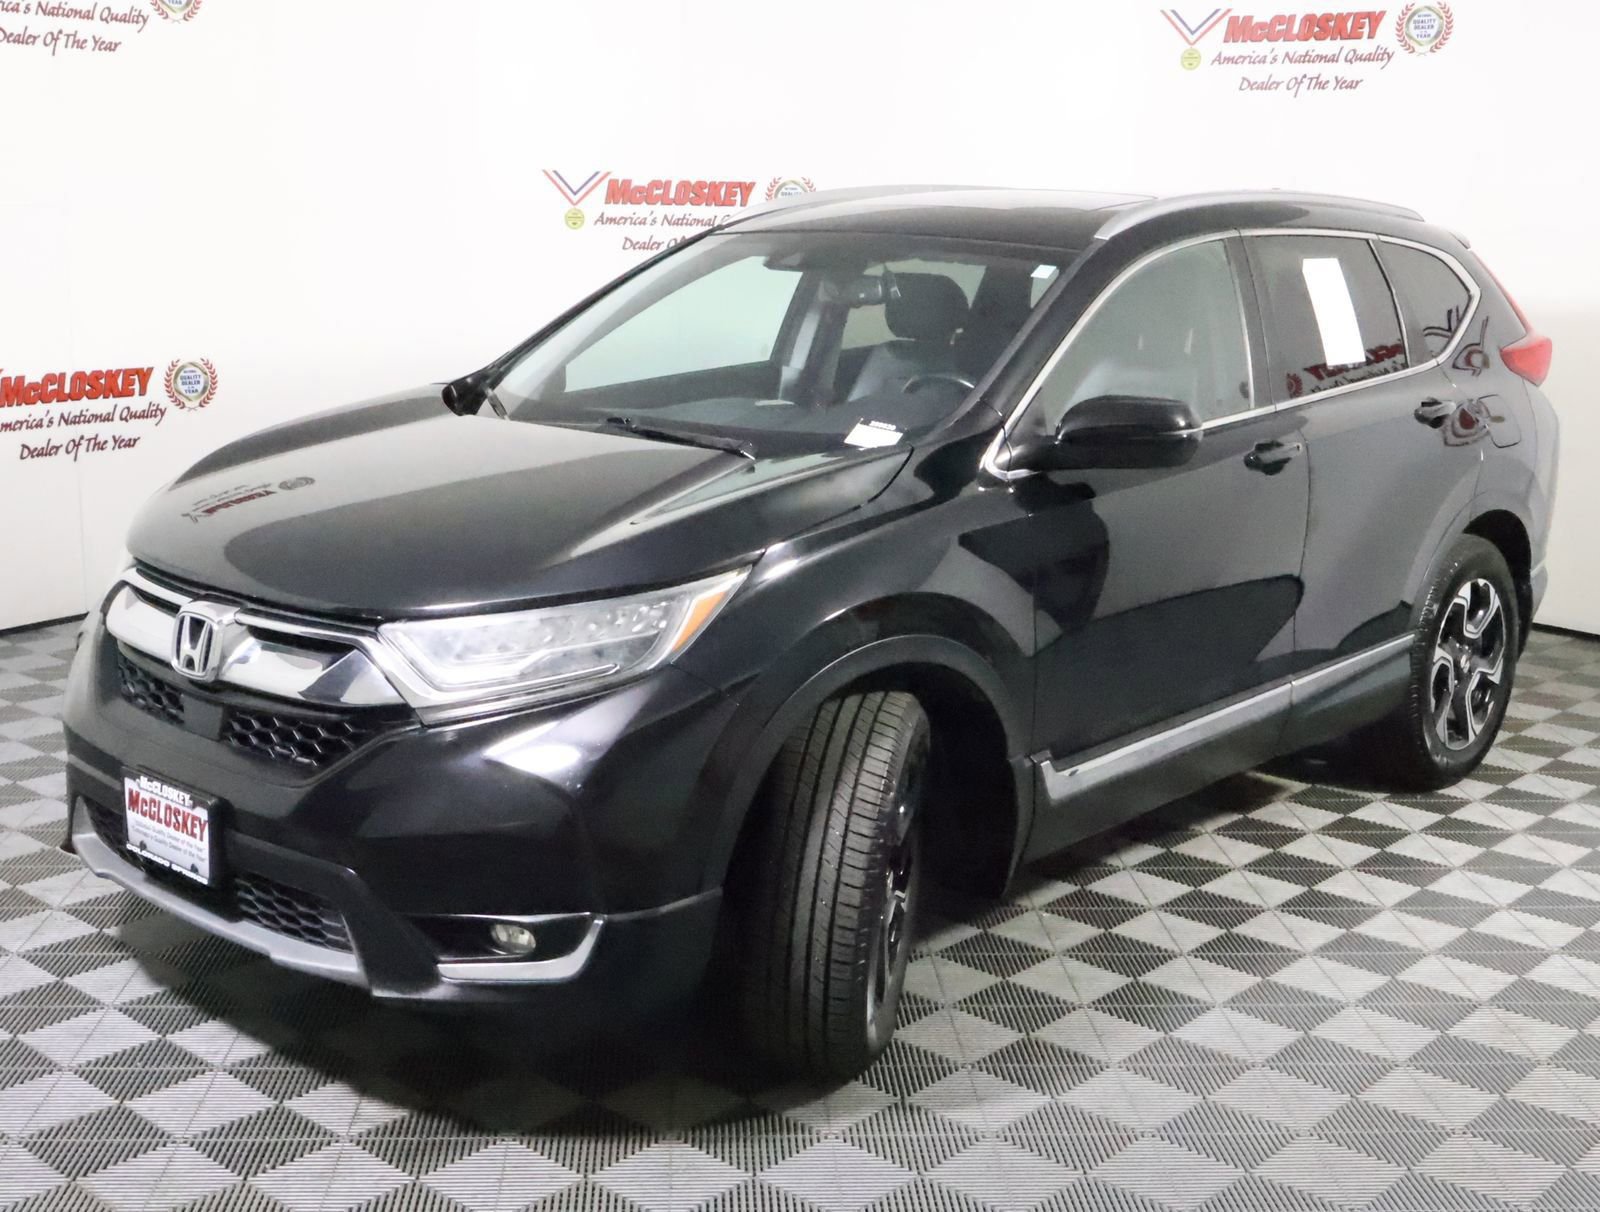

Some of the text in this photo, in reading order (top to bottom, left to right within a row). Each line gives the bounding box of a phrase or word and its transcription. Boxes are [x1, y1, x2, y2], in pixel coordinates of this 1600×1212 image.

[35, 0, 97, 21] National
[99, 6, 149, 33] Quality
[1223, 10, 1387, 43] McCLOSKEY
[43, 29, 63, 56] Of
[64, 30, 88, 50] The
[92, 35, 122, 52] Year
[1210, 48, 1278, 66] America's
[1282, 46, 1344, 65] National
[1344, 44, 1395, 70] Quality
[1238, 72, 1364, 98] Dealer Of The Year
[604, 179, 756, 207] McCLOSKEY
[593, 210, 657, 226] America's
[660, 213, 717, 228] National
[622, 234, 665, 251] Dealer
[0, 367, 154, 408] McCLOSKEY
[0, 401, 167, 432] merica's National Quality
[19, 433, 141, 462] Dealer Of The Year
[128, 787, 208, 842] McCLOSKEY
